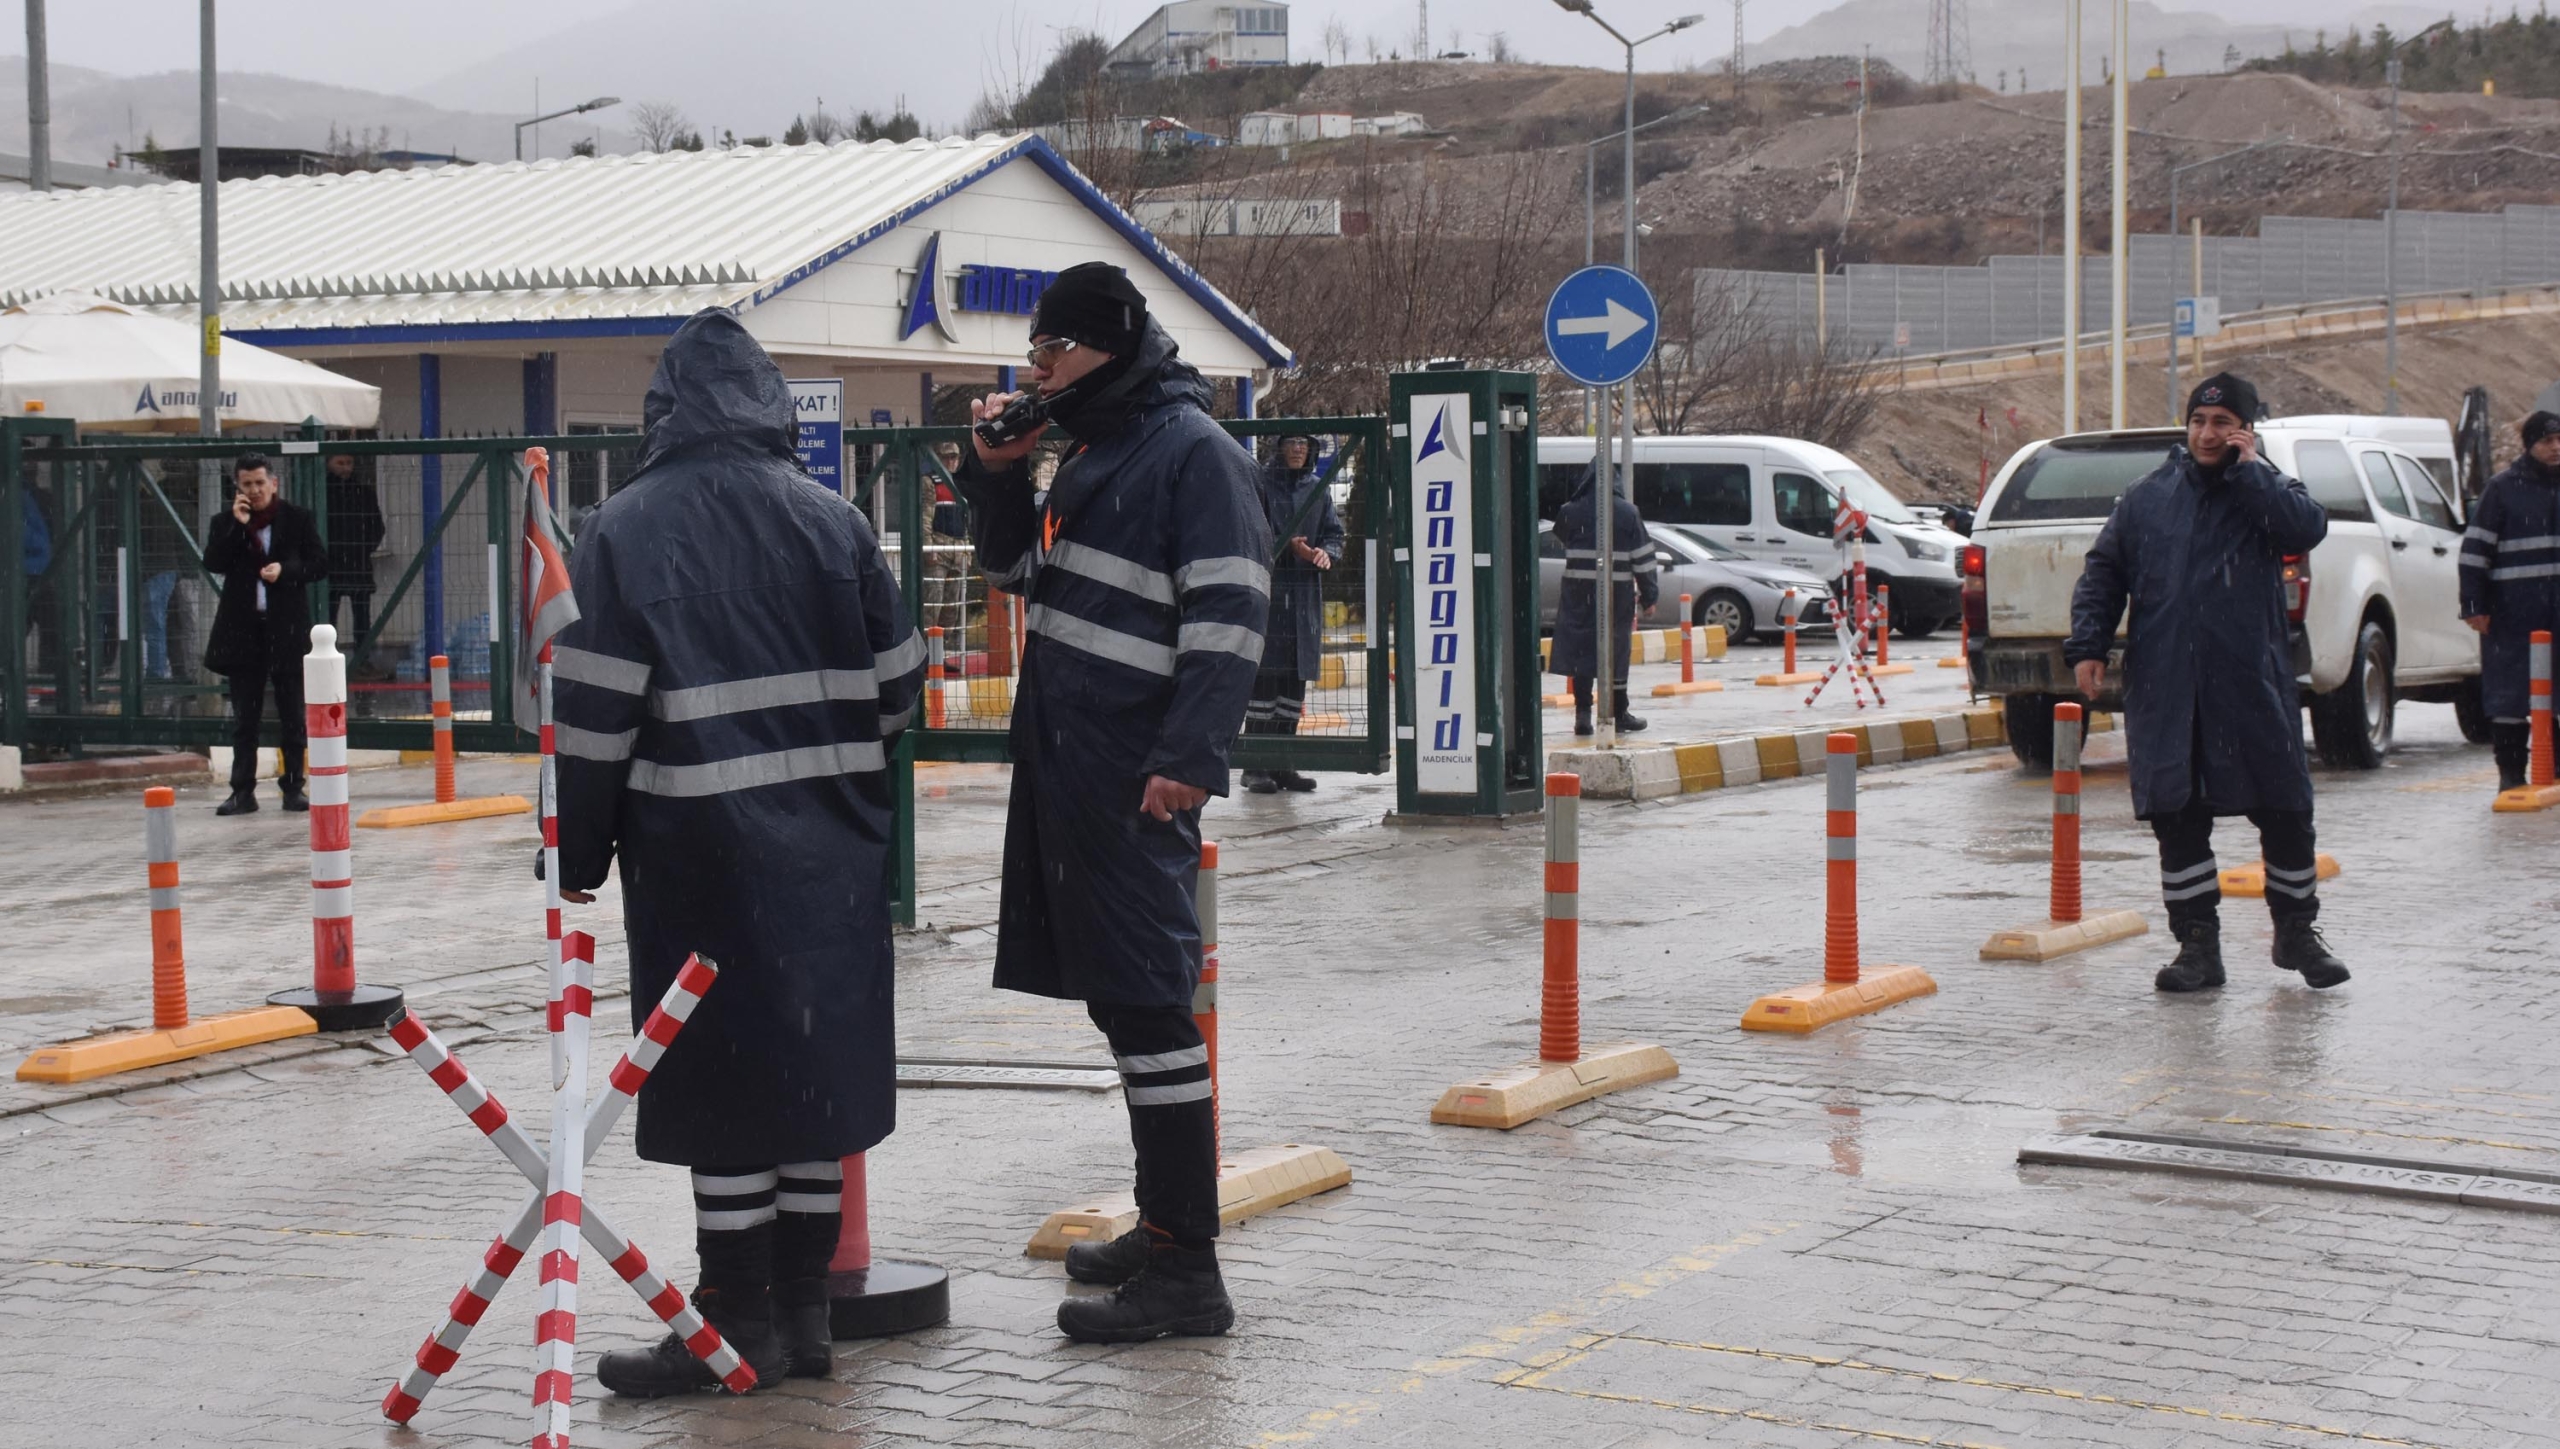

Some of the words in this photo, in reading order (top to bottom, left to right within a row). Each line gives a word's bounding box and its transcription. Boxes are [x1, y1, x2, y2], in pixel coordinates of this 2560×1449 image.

[162, 391, 237, 407] anald
[794, 395, 827, 411] KAT
[797, 439, 826, 448] ÜLEME
[795, 452, 811, 461] EMİ
[806, 466, 836, 475] KLEME
[1426, 481, 1461, 750] anagold
[1422, 754, 1473, 763] MADENCİLİK
[899, 1067, 948, 1076] VSS
[2357, 1167, 2462, 1187] UVSS
